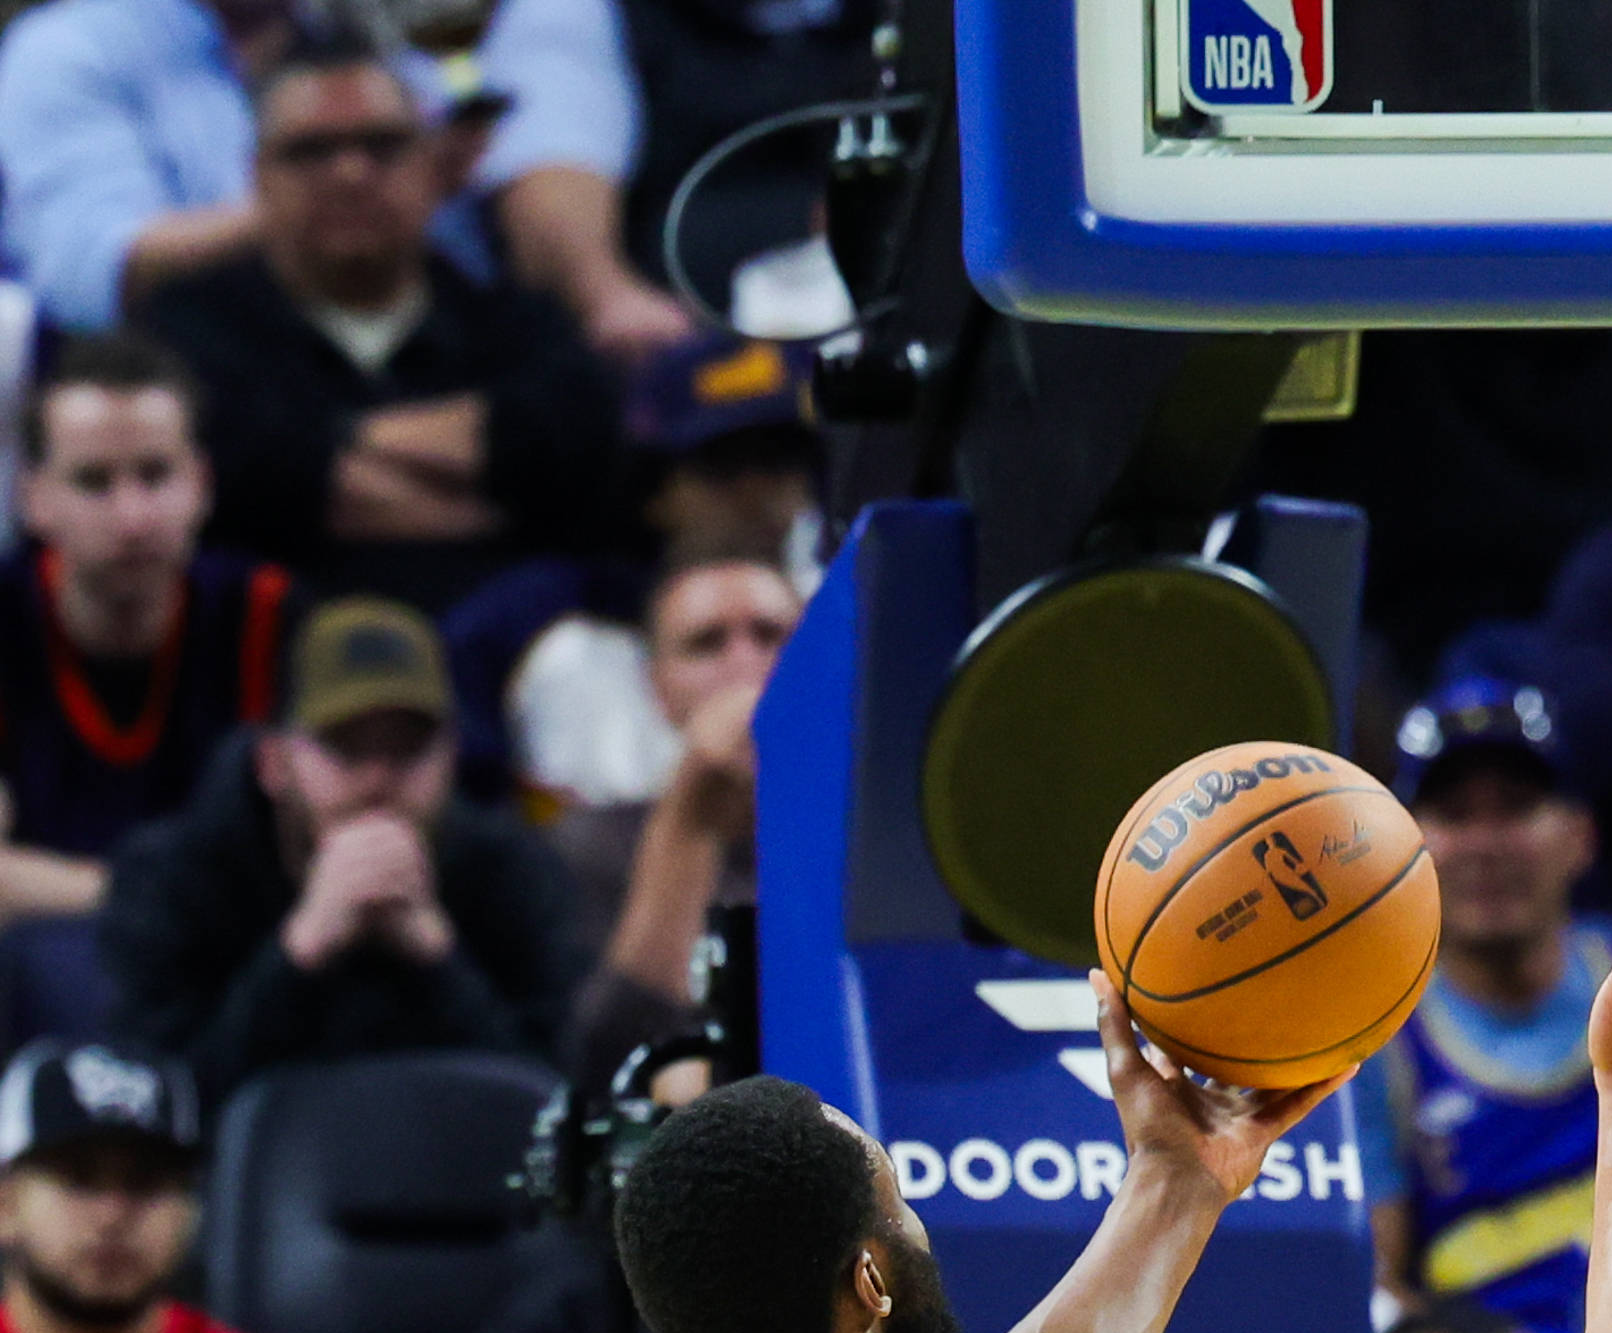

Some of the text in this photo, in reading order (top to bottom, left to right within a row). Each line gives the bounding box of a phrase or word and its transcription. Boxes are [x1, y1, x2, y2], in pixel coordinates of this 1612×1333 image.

[1204, 34, 1275, 90] NBA
[1126, 753, 1334, 873] Wilson
[888, 1137, 1365, 1201] DOORSH
